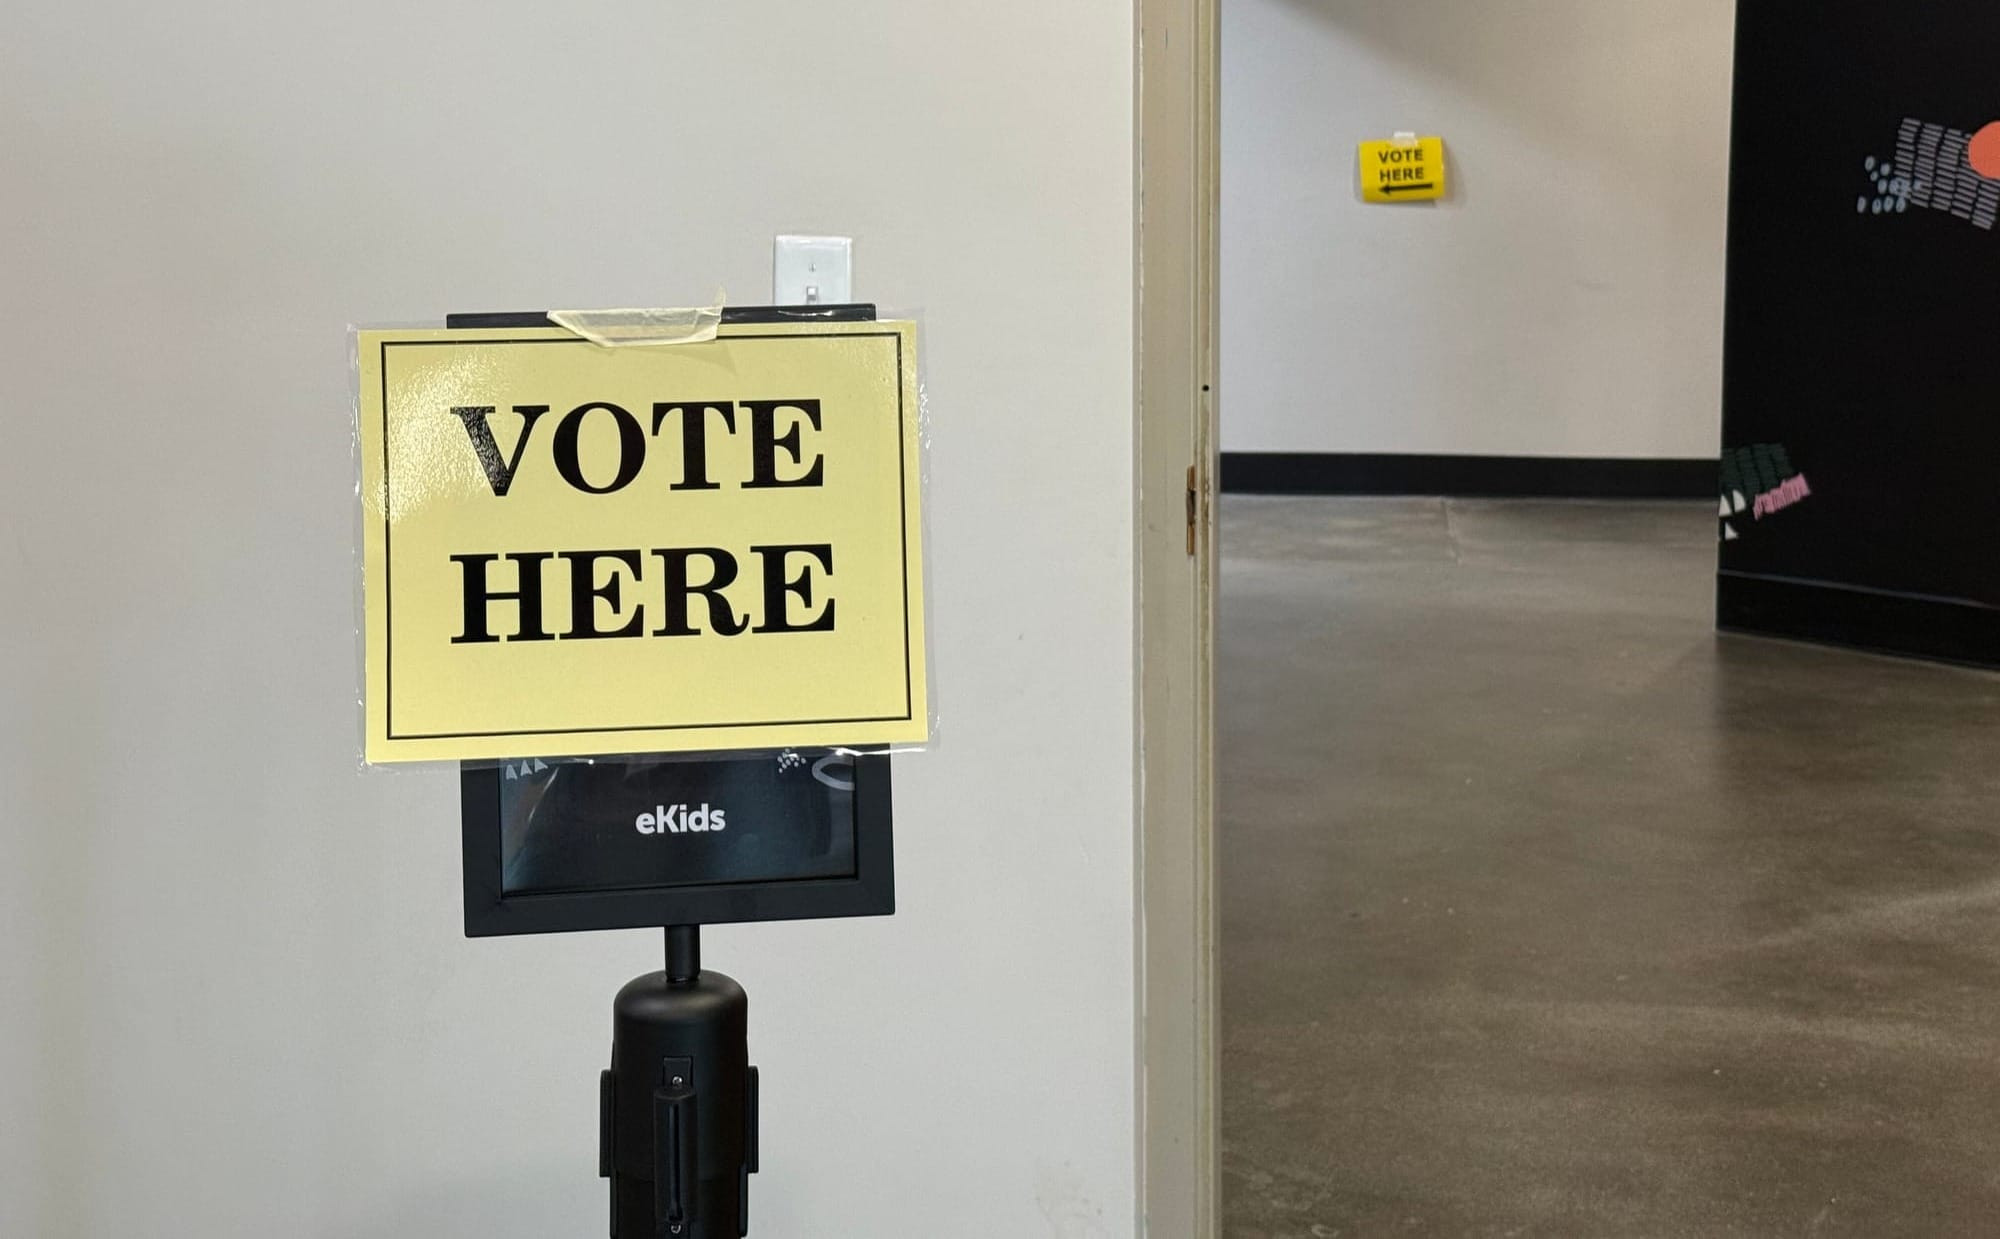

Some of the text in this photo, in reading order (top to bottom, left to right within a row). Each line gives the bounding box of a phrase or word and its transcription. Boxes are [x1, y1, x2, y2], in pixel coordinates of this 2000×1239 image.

[1377, 149, 1424, 164] VOTE
[1379, 167, 1424, 182] HERE
[449, 399, 824, 497] VOTE
[449, 543, 836, 645] HERE
[635, 803, 727, 835] eKids
